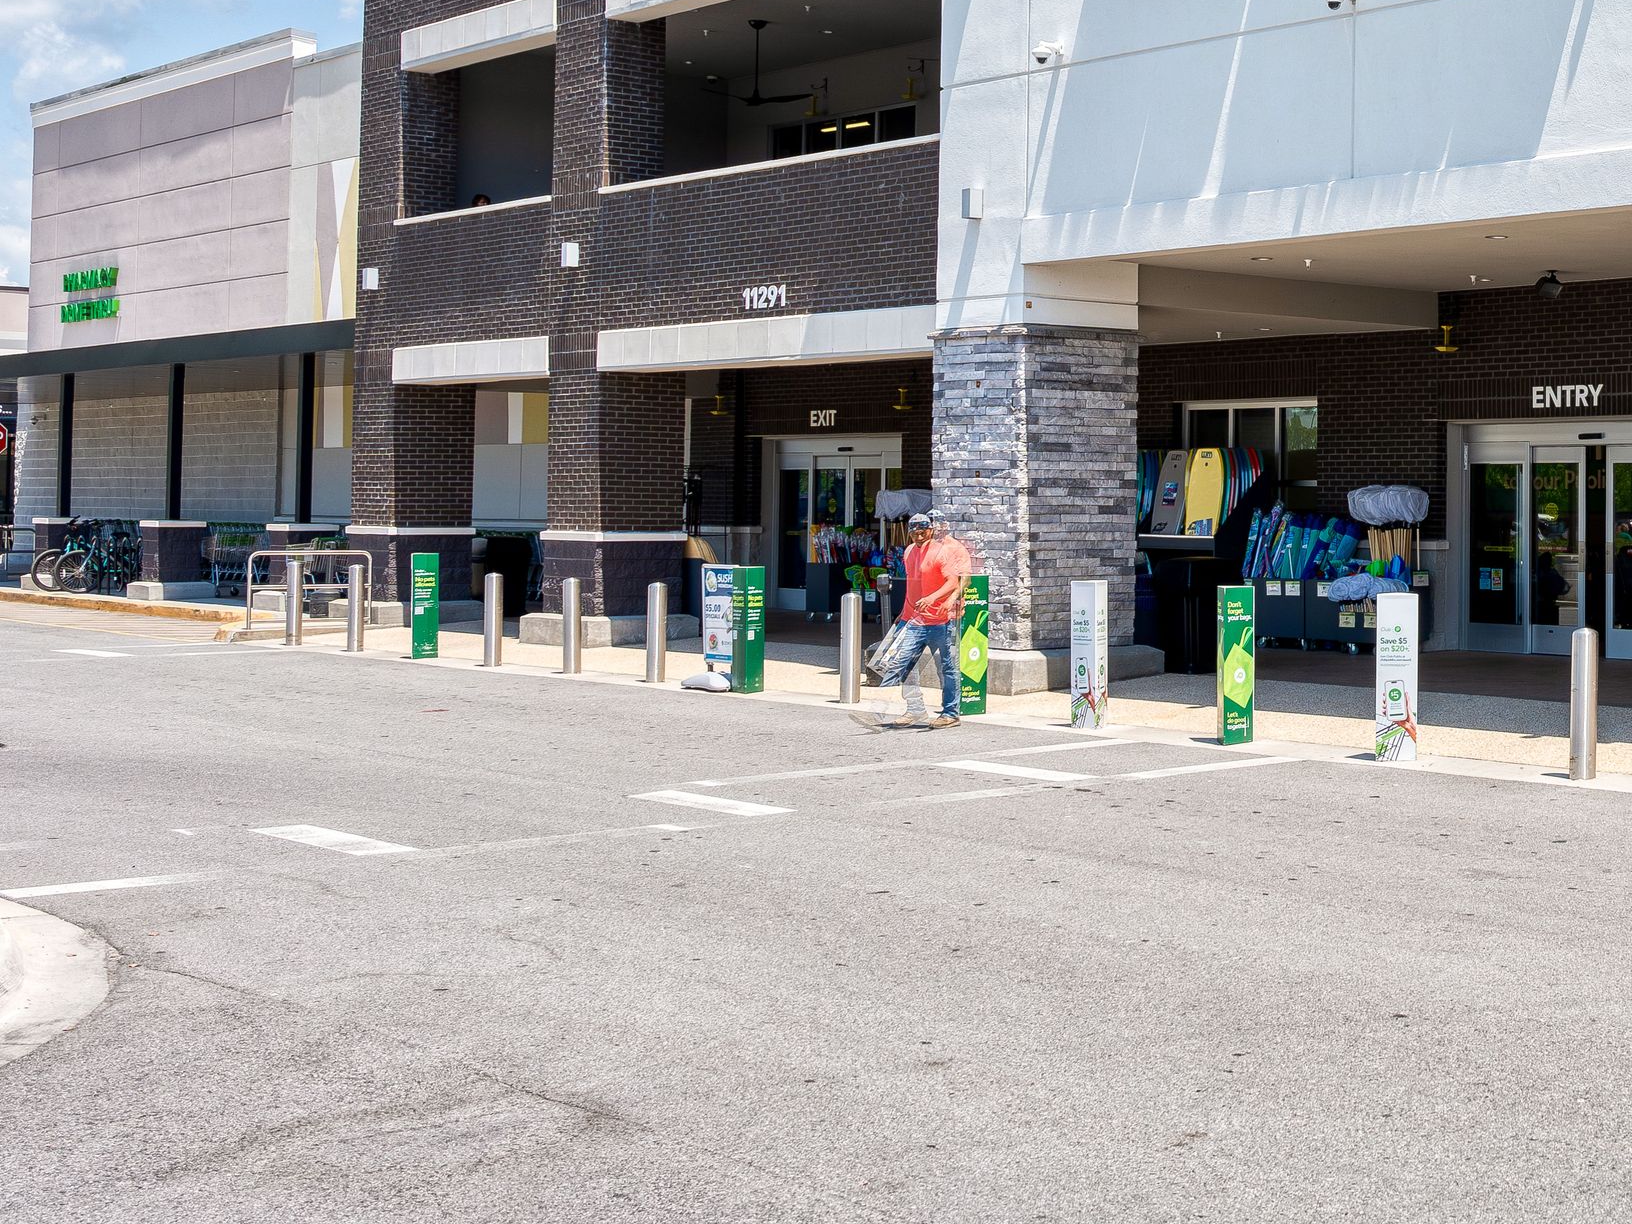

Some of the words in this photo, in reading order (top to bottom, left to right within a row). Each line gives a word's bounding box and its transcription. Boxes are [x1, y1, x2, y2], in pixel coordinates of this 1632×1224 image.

[743, 284, 787, 310] 11291
[1532, 384, 1604, 409] ENTRY
[810, 410, 838, 427] EXIT
[717, 573, 733, 583] SUSH
[1227, 607, 1244, 616] forget
[1227, 615, 1240, 623] your
[1380, 637, 1397, 645] Save
[1398, 637, 1408, 645] $5
[1390, 691, 1399, 699] $5
